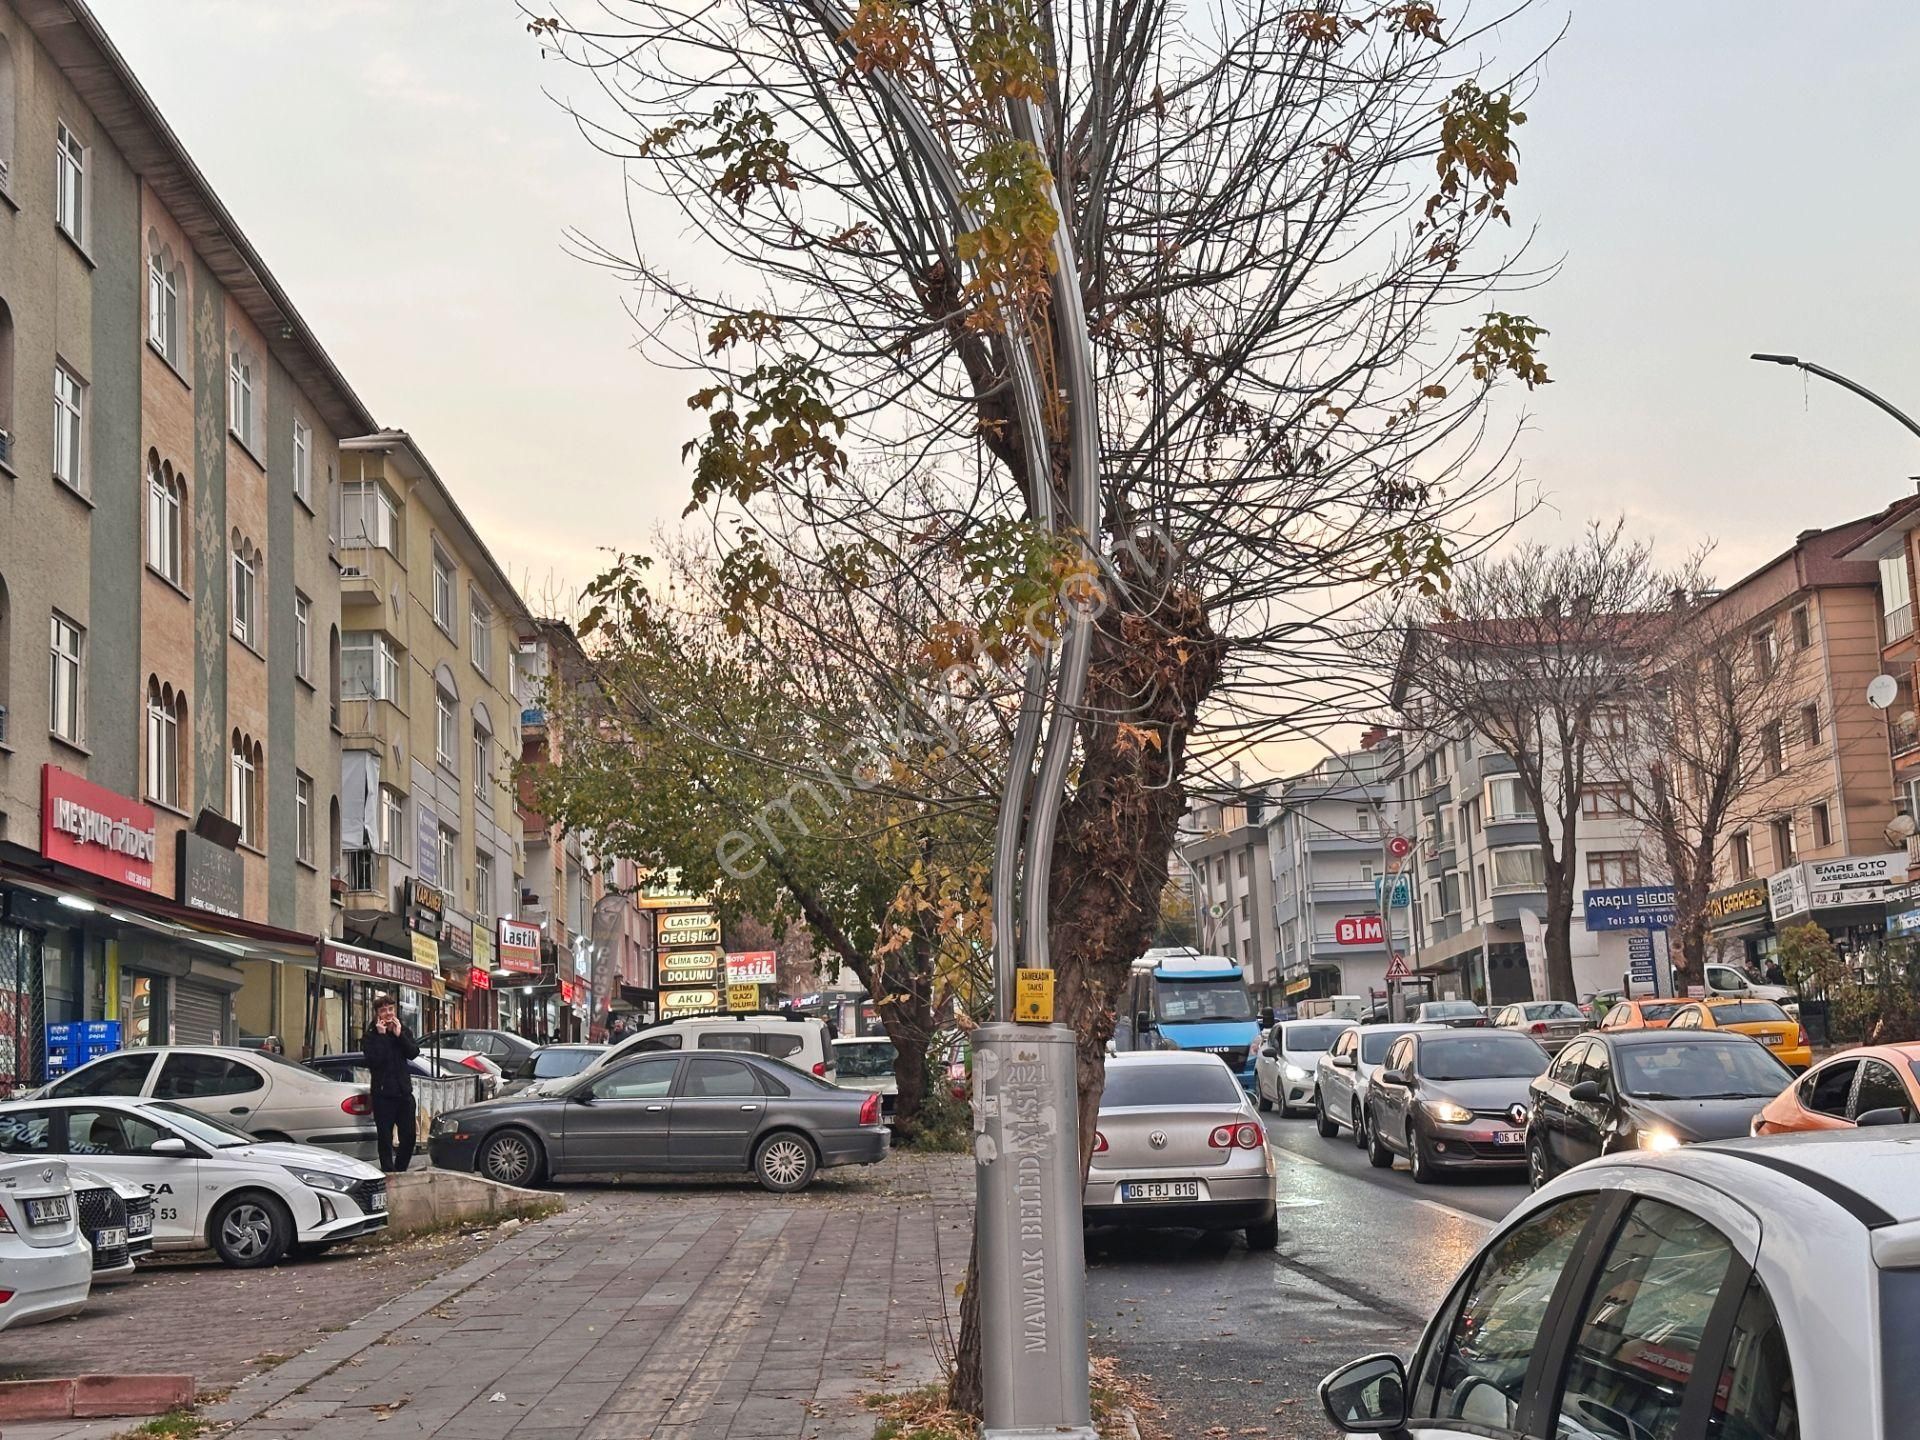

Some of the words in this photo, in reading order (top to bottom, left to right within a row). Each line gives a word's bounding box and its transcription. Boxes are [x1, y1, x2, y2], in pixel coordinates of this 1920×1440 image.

[53, 797, 113, 850] MEŞHUR
[1815, 863, 1854, 875] EMRE
[1857, 860, 1888, 870] OTO
[1588, 894, 1632, 910] ARAÇLI
[671, 916, 707, 926] LASTİK
[1608, 917, 1626, 925] Tel:
[1628, 915, 1646, 923] 389
[1649, 914, 1653, 923] 1
[503, 927, 537, 948] Lastik
[1341, 920, 1382, 941] BİM
[668, 957, 691, 965] KLİMA
[727, 961, 772, 976] astik
[667, 970, 713, 981] DOLUMU
[1007, 1064, 1048, 1082] 2021
[1500, 1133, 1510, 1142] 06
[1129, 1186, 1143, 1196] 06
[1148, 1185, 1169, 1196] FBJ
[1175, 1183, 1195, 1195] 816
[161, 1208, 177, 1220] 53
[1021, 1248, 1047, 1354] MAMAK
